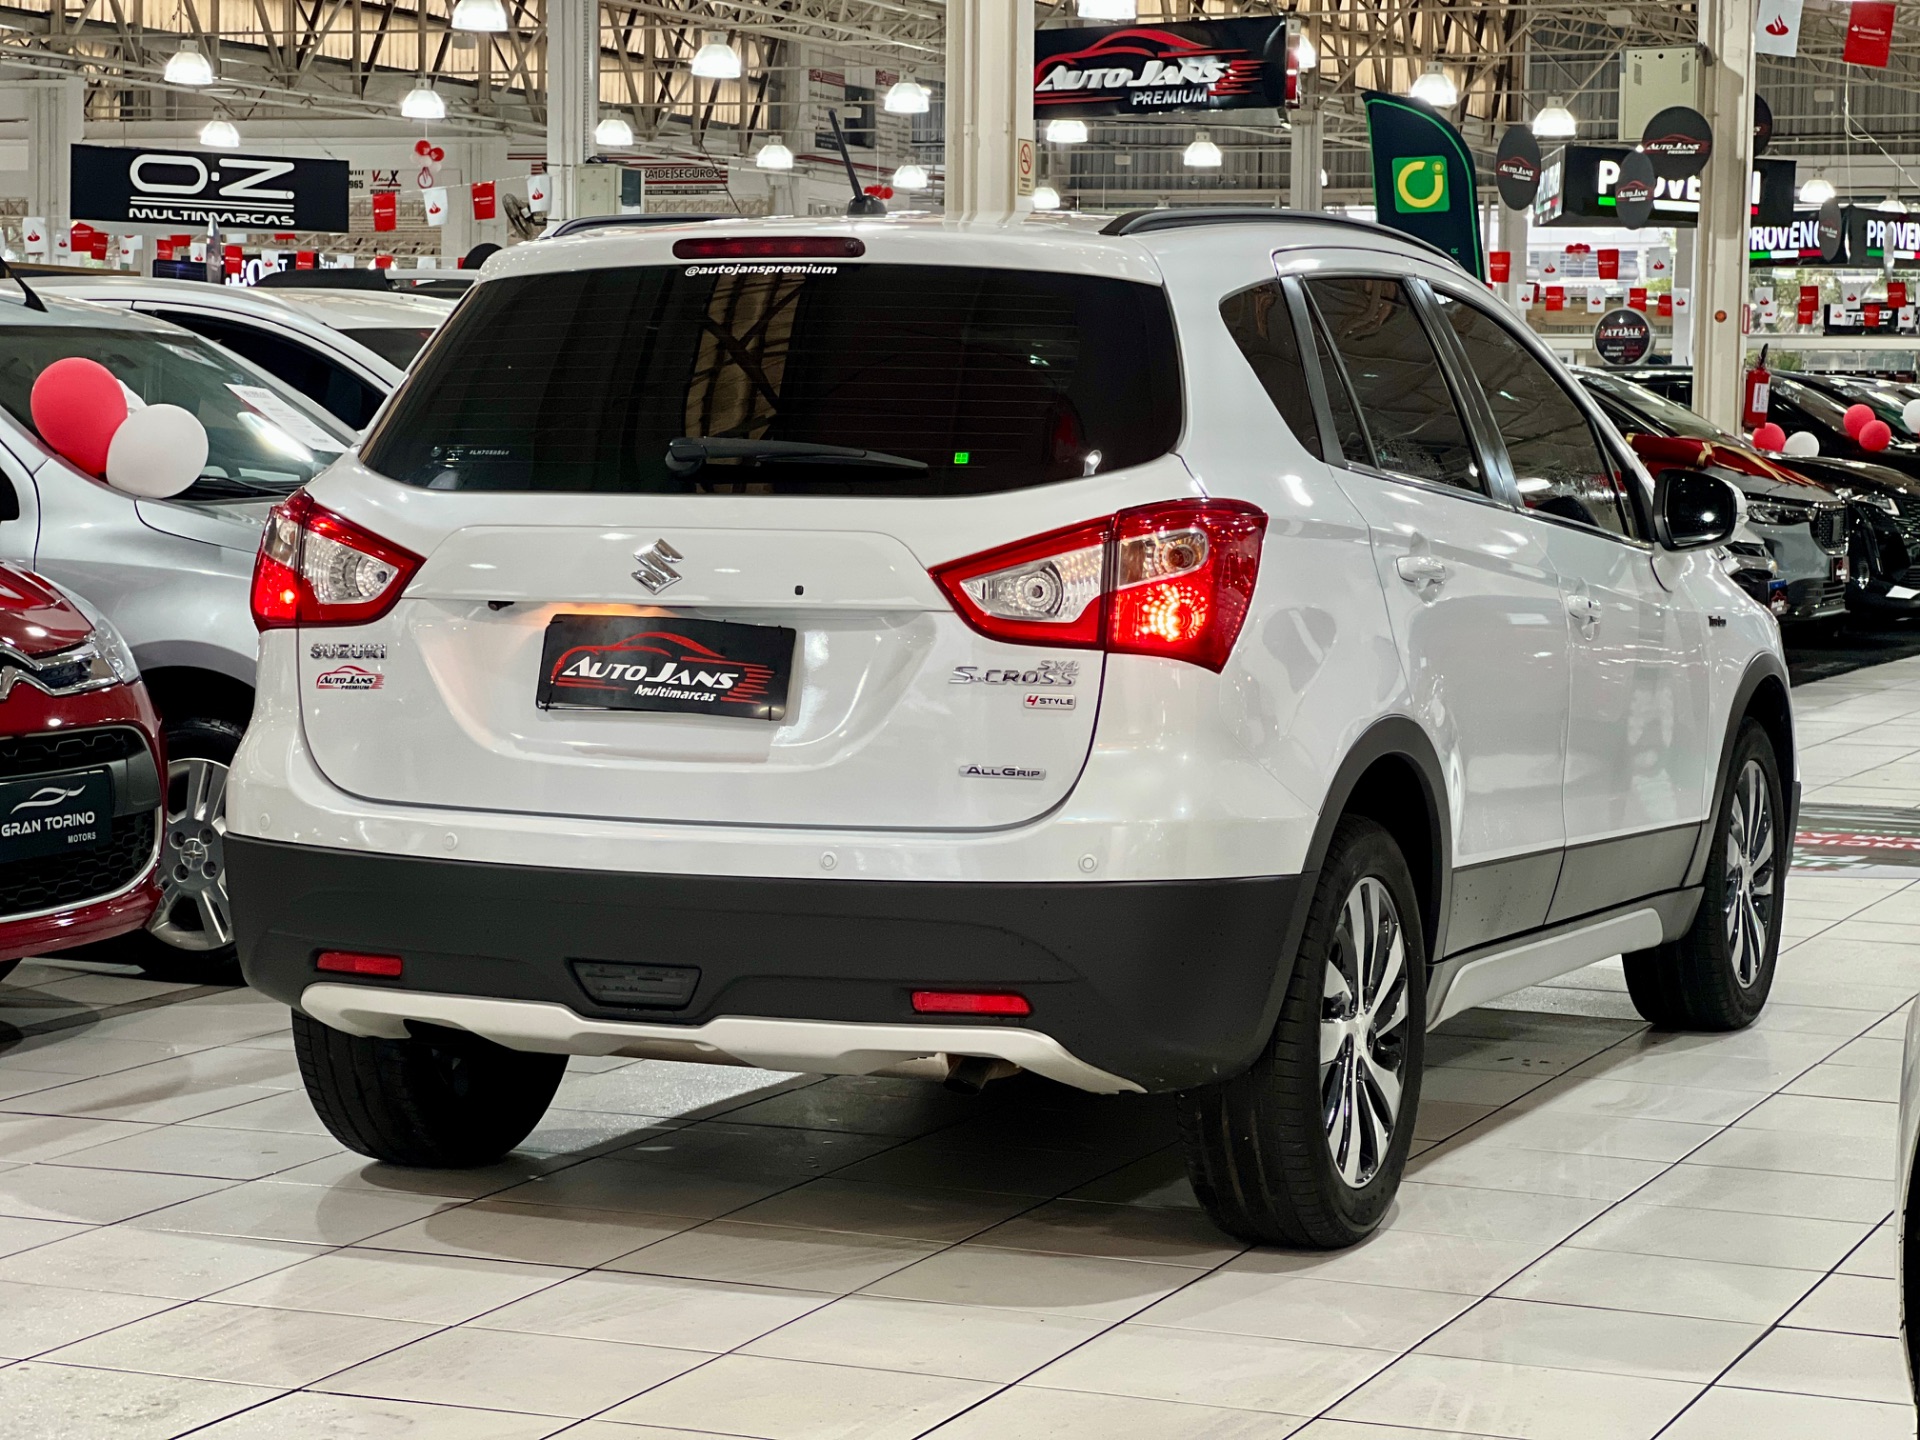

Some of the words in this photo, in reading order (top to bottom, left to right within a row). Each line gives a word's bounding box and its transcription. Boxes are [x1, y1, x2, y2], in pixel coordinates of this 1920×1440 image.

[1132, 88, 1208, 105] PREMIUM
[673, 168, 720, 178] SEGUROS
[129, 208, 295, 225] MULTIMARCAS
[685, 264, 838, 276] @autojanspremium
[310, 643, 388, 660] SUZUKI
[1037, 660, 1079, 672] SX4
[634, 685, 717, 702] Multimarcas
[1, 819, 41, 837] GRAN
[45, 811, 95, 830] TORINO
[67, 831, 97, 844] MOTORS
